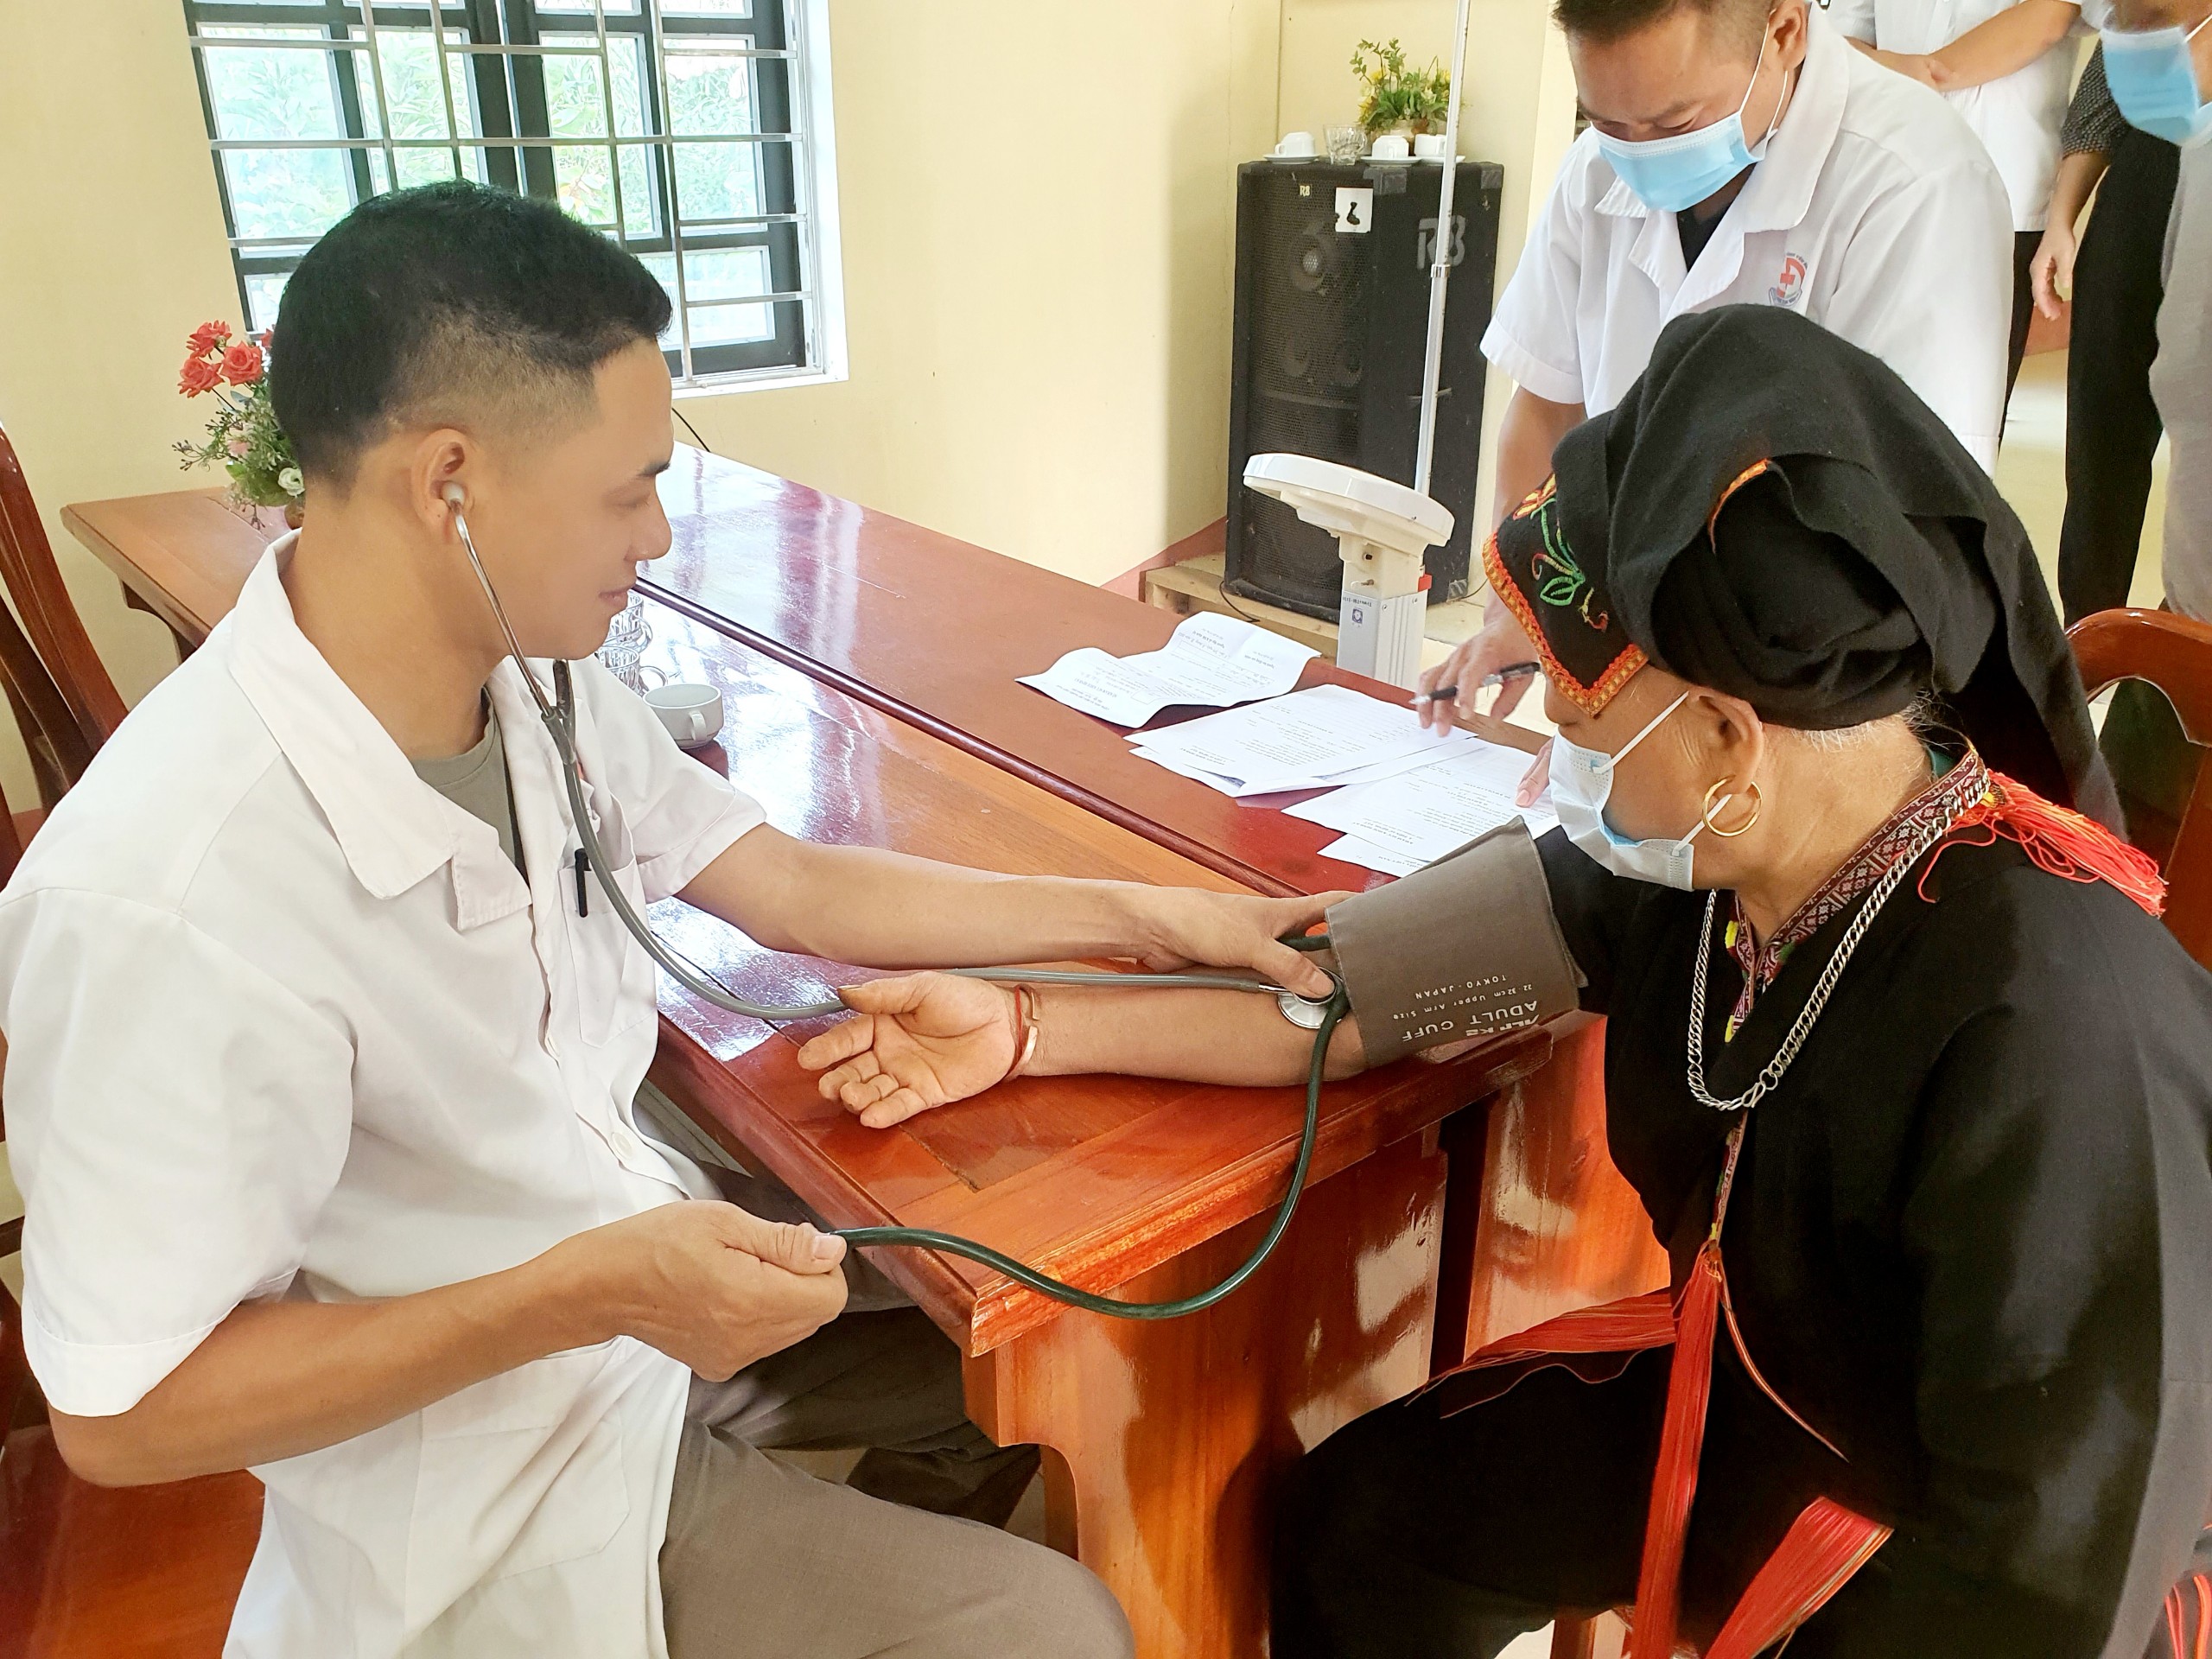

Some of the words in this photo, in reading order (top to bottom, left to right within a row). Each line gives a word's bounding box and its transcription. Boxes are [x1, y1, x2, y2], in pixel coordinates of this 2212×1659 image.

[1300, 185, 1311, 197] R8
[1453, 995, 1486, 1006] Upper
[1424, 1003, 1446, 1014] Arm
[1470, 1000, 1538, 1025] ADULT
[1393, 1010, 1417, 1020] Size
[1402, 1020, 1454, 1042] CUFF
